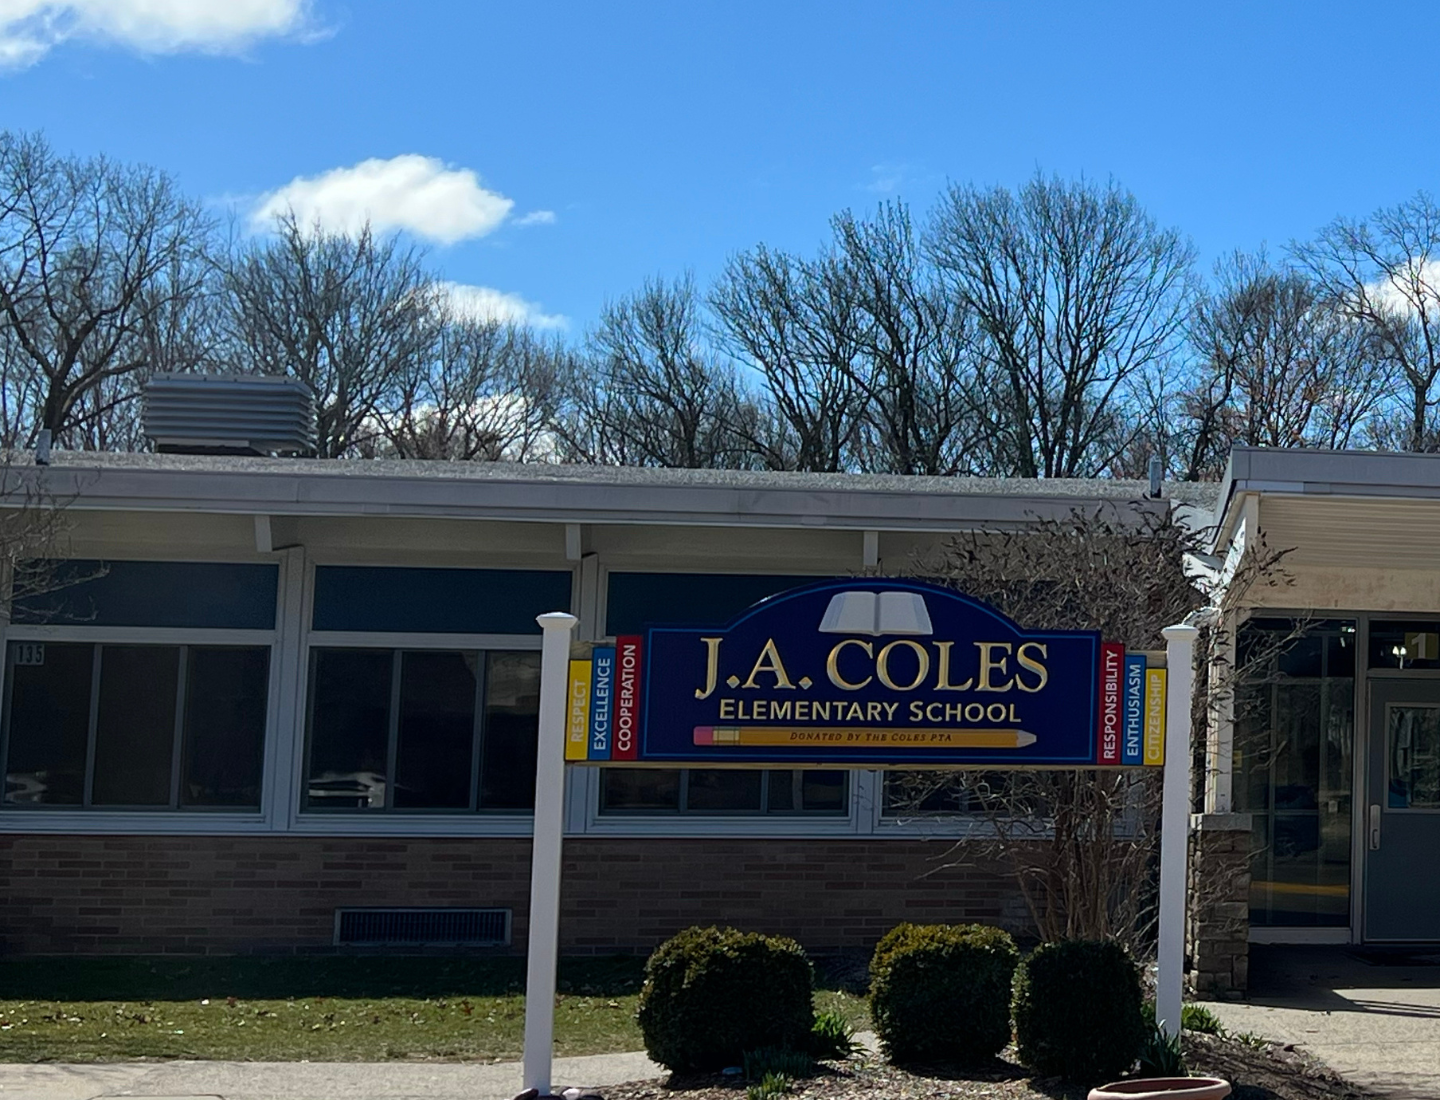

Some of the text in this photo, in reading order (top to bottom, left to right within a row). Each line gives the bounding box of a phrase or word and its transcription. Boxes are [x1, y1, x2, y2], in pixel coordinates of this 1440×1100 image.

[18, 645, 43, 663] 135
[694, 637, 1048, 700] J.A. COLES
[1411, 632, 1426, 659] 1
[570, 679, 586, 742] RESPECT
[593, 658, 610, 750] EXCELLENCE
[617, 644, 636, 751] COOPERATION
[719, 698, 1022, 722] ELEMENTARY SCHOOL
[1103, 650, 1118, 759] RESPONSIBILITY
[1126, 664, 1141, 756] ENTHUSIASM
[1148, 674, 1162, 760] CITIZENSHIP
[789, 731, 952, 742] DONATED BY THE COLES PTA
